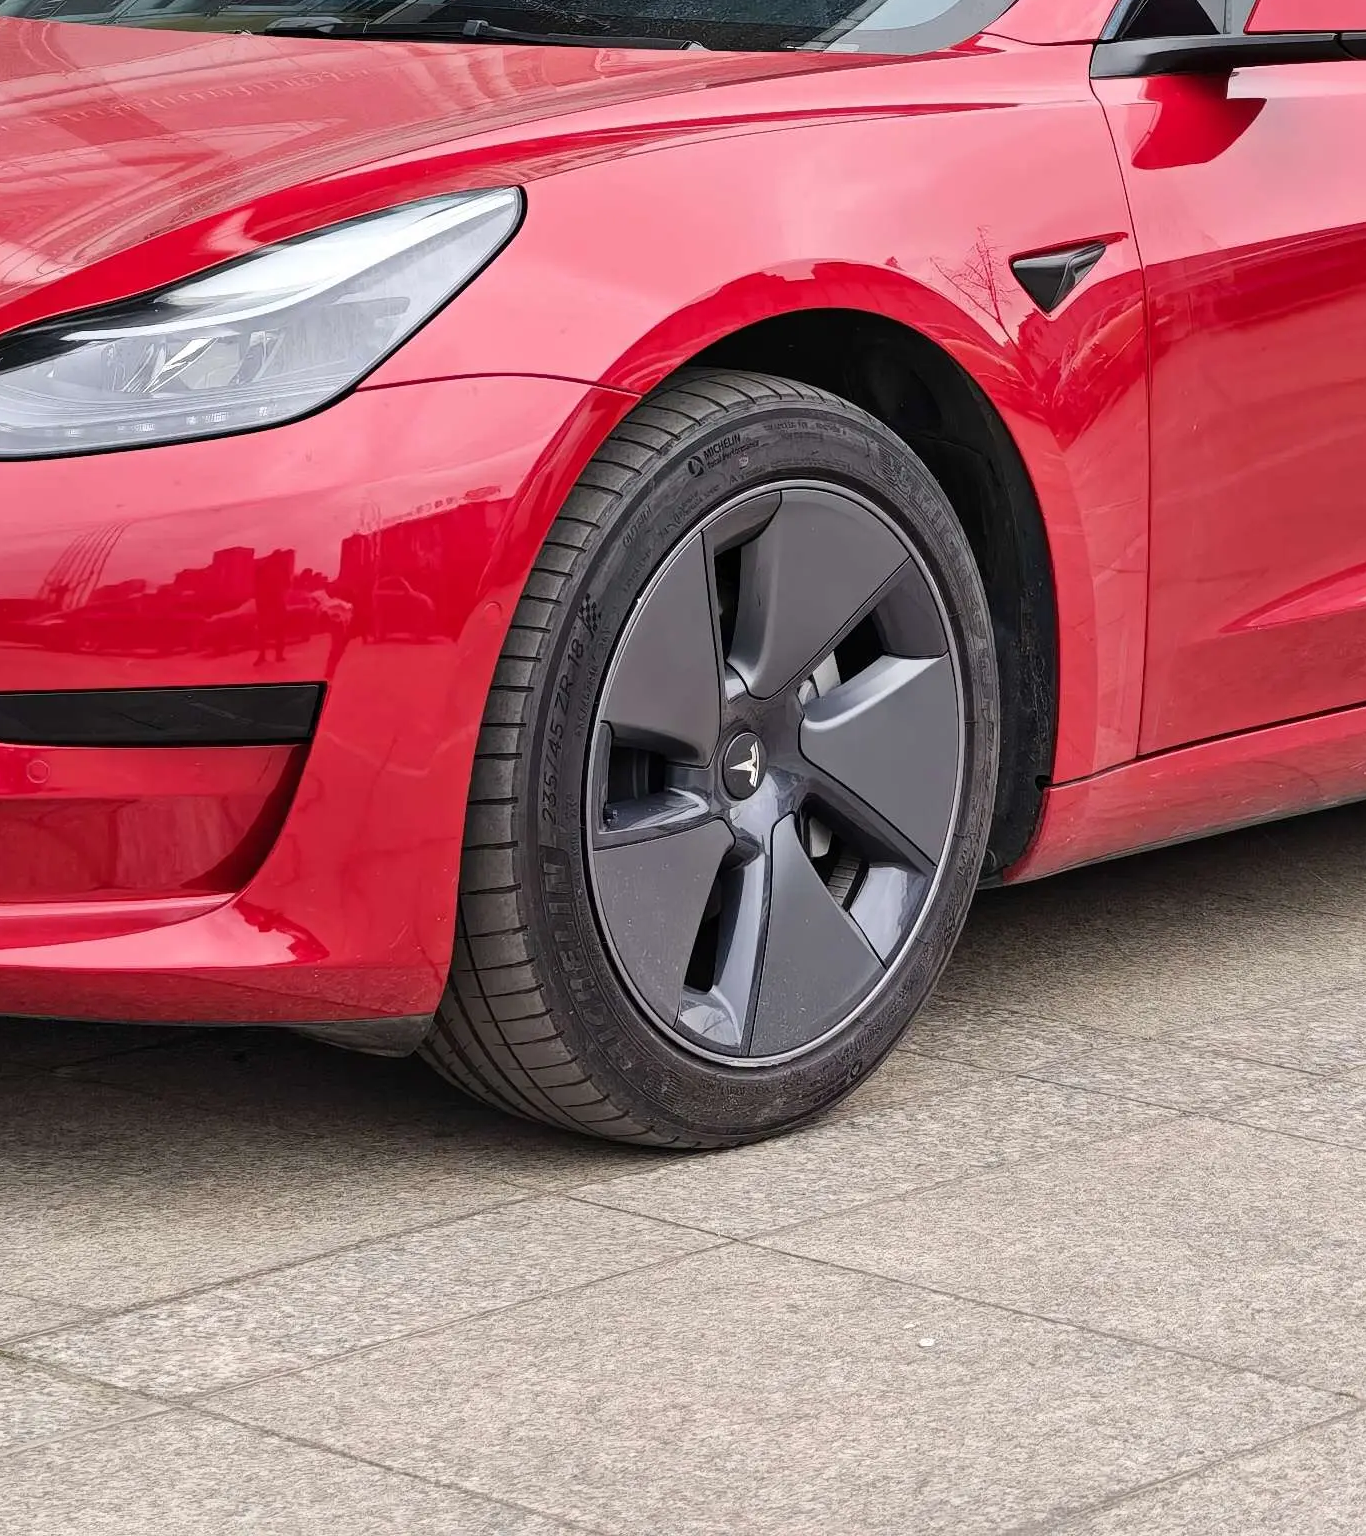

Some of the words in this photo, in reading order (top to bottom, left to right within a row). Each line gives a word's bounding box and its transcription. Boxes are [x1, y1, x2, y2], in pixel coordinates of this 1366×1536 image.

[703, 434, 741, 460] MICHELIN
[541, 723, 564, 826] 235/45
[567, 638, 585, 666] 18
